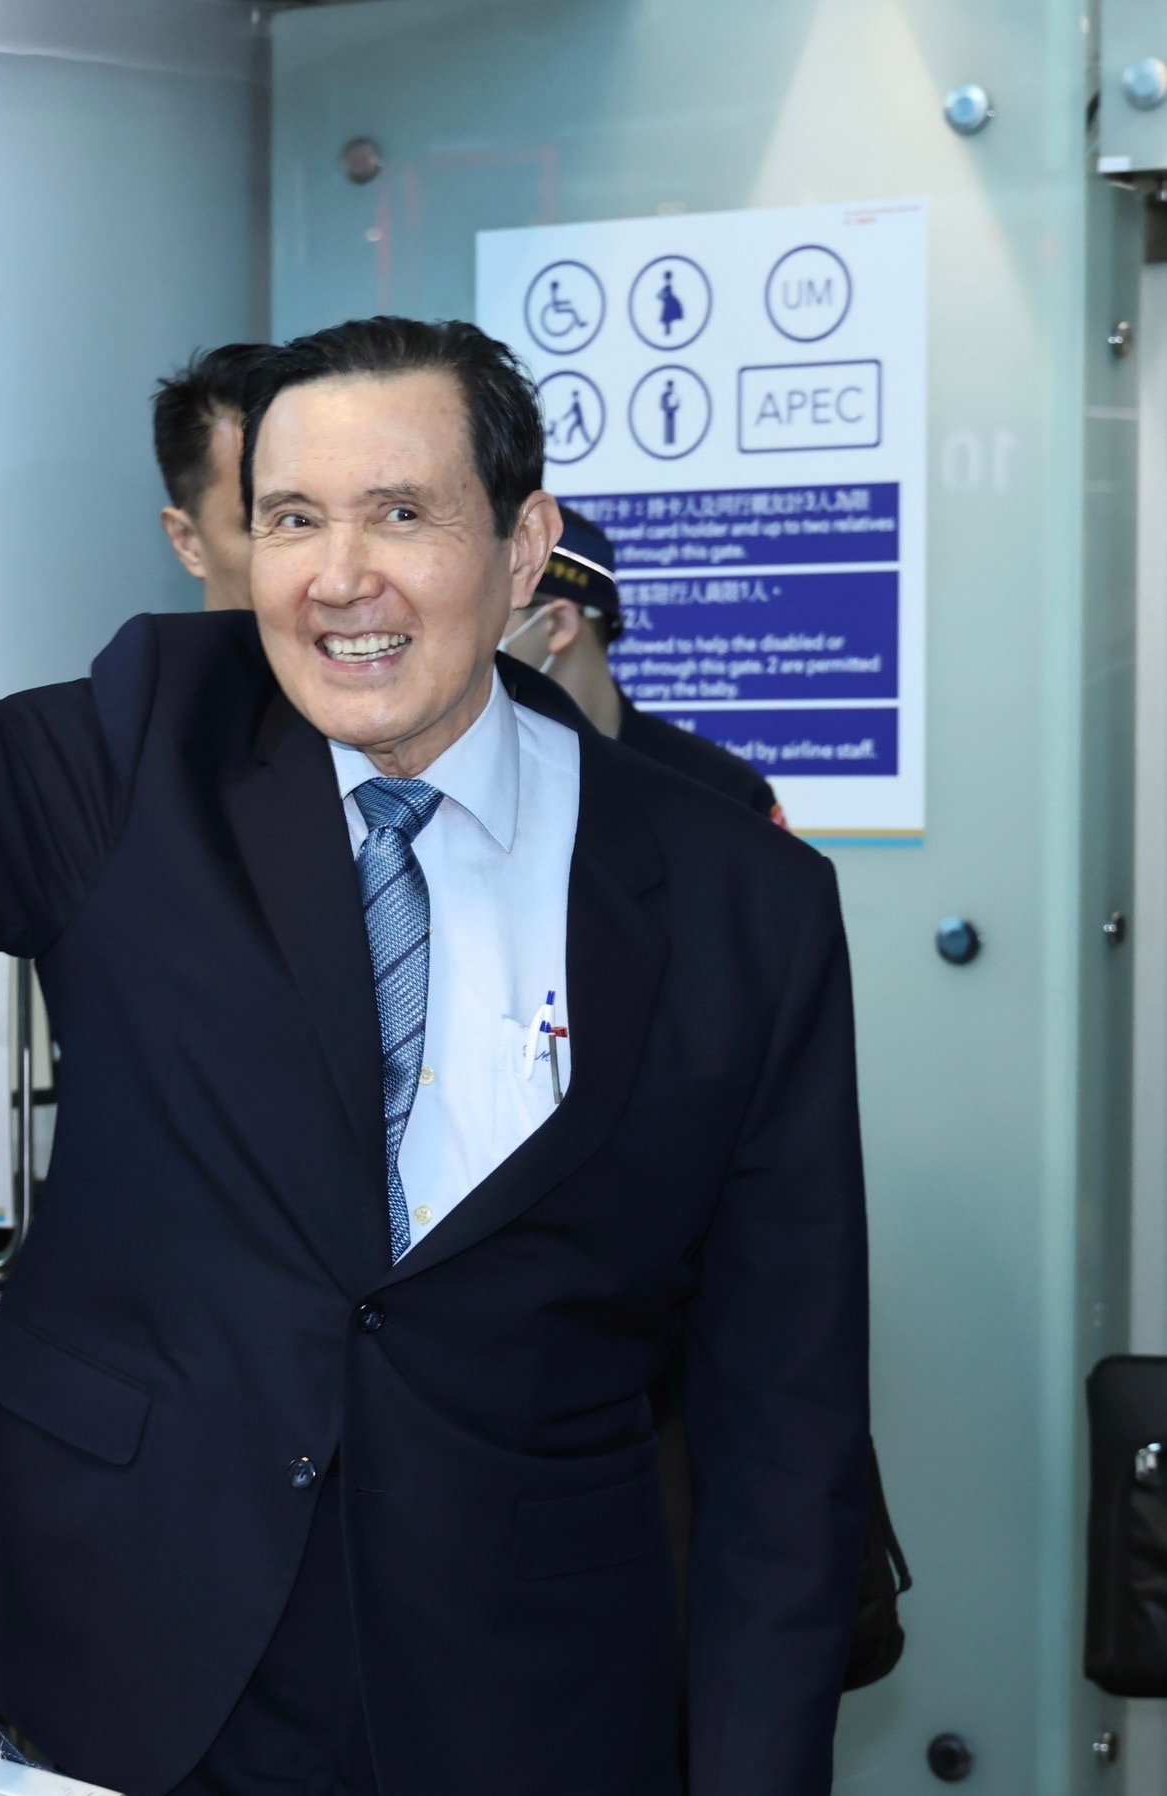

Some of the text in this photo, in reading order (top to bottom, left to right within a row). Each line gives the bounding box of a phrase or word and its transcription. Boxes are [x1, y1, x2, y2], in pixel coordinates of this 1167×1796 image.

[782, 279, 833, 311] UM
[755, 386, 864, 427] APEC
[681, 521, 727, 539] holder
[731, 518, 759, 537] and
[762, 520, 782, 539] up
[784, 518, 801, 535] to
[802, 517, 830, 534] two
[833, 515, 895, 532] relatives
[621, 544, 679, 565] through
[681, 544, 707, 561] this
[619, 635, 674, 654] allowed
[677, 637, 693, 654] to
[695, 635, 729, 655] help
[731, 634, 757, 652] the
[759, 633, 825, 653] disabled
[827, 635, 845, 652] or
[640, 658, 697, 680] through
[699, 657, 725, 675] this
[766, 655, 779, 674] 2
[780, 659, 804, 675] are
[806, 653, 882, 677] permitted
[672, 681, 697, 697] the
[754, 740, 778, 764] by
[781, 740, 833, 760] airline
[836, 737, 877, 760] staff.
